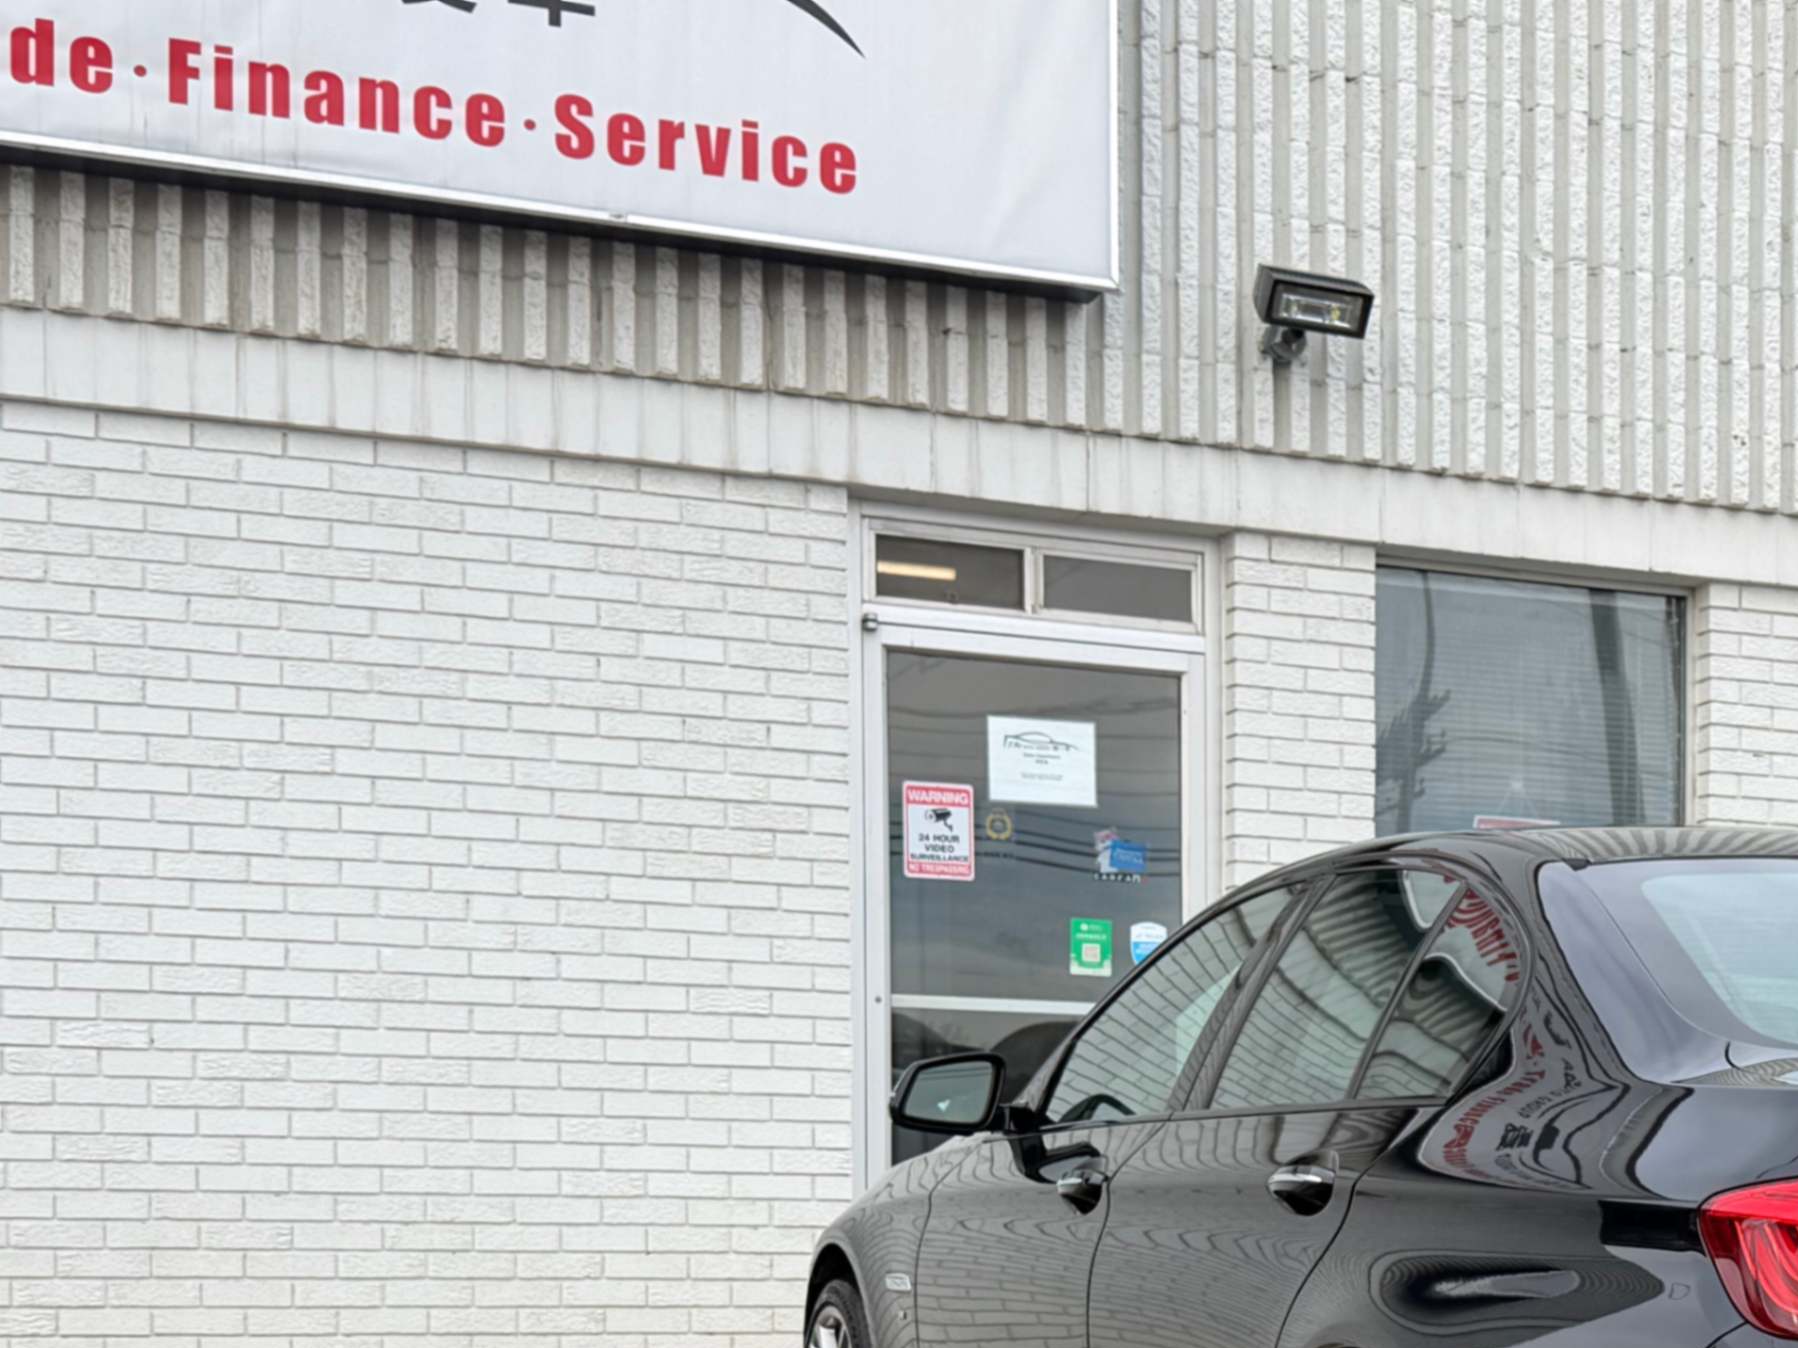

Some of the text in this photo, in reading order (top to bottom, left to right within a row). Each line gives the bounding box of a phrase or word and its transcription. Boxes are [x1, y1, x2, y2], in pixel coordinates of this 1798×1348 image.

[908, 788, 969, 806] WARNING
[933, 834, 960, 844] HOUR
[924, 844, 955, 853] VIDEO
